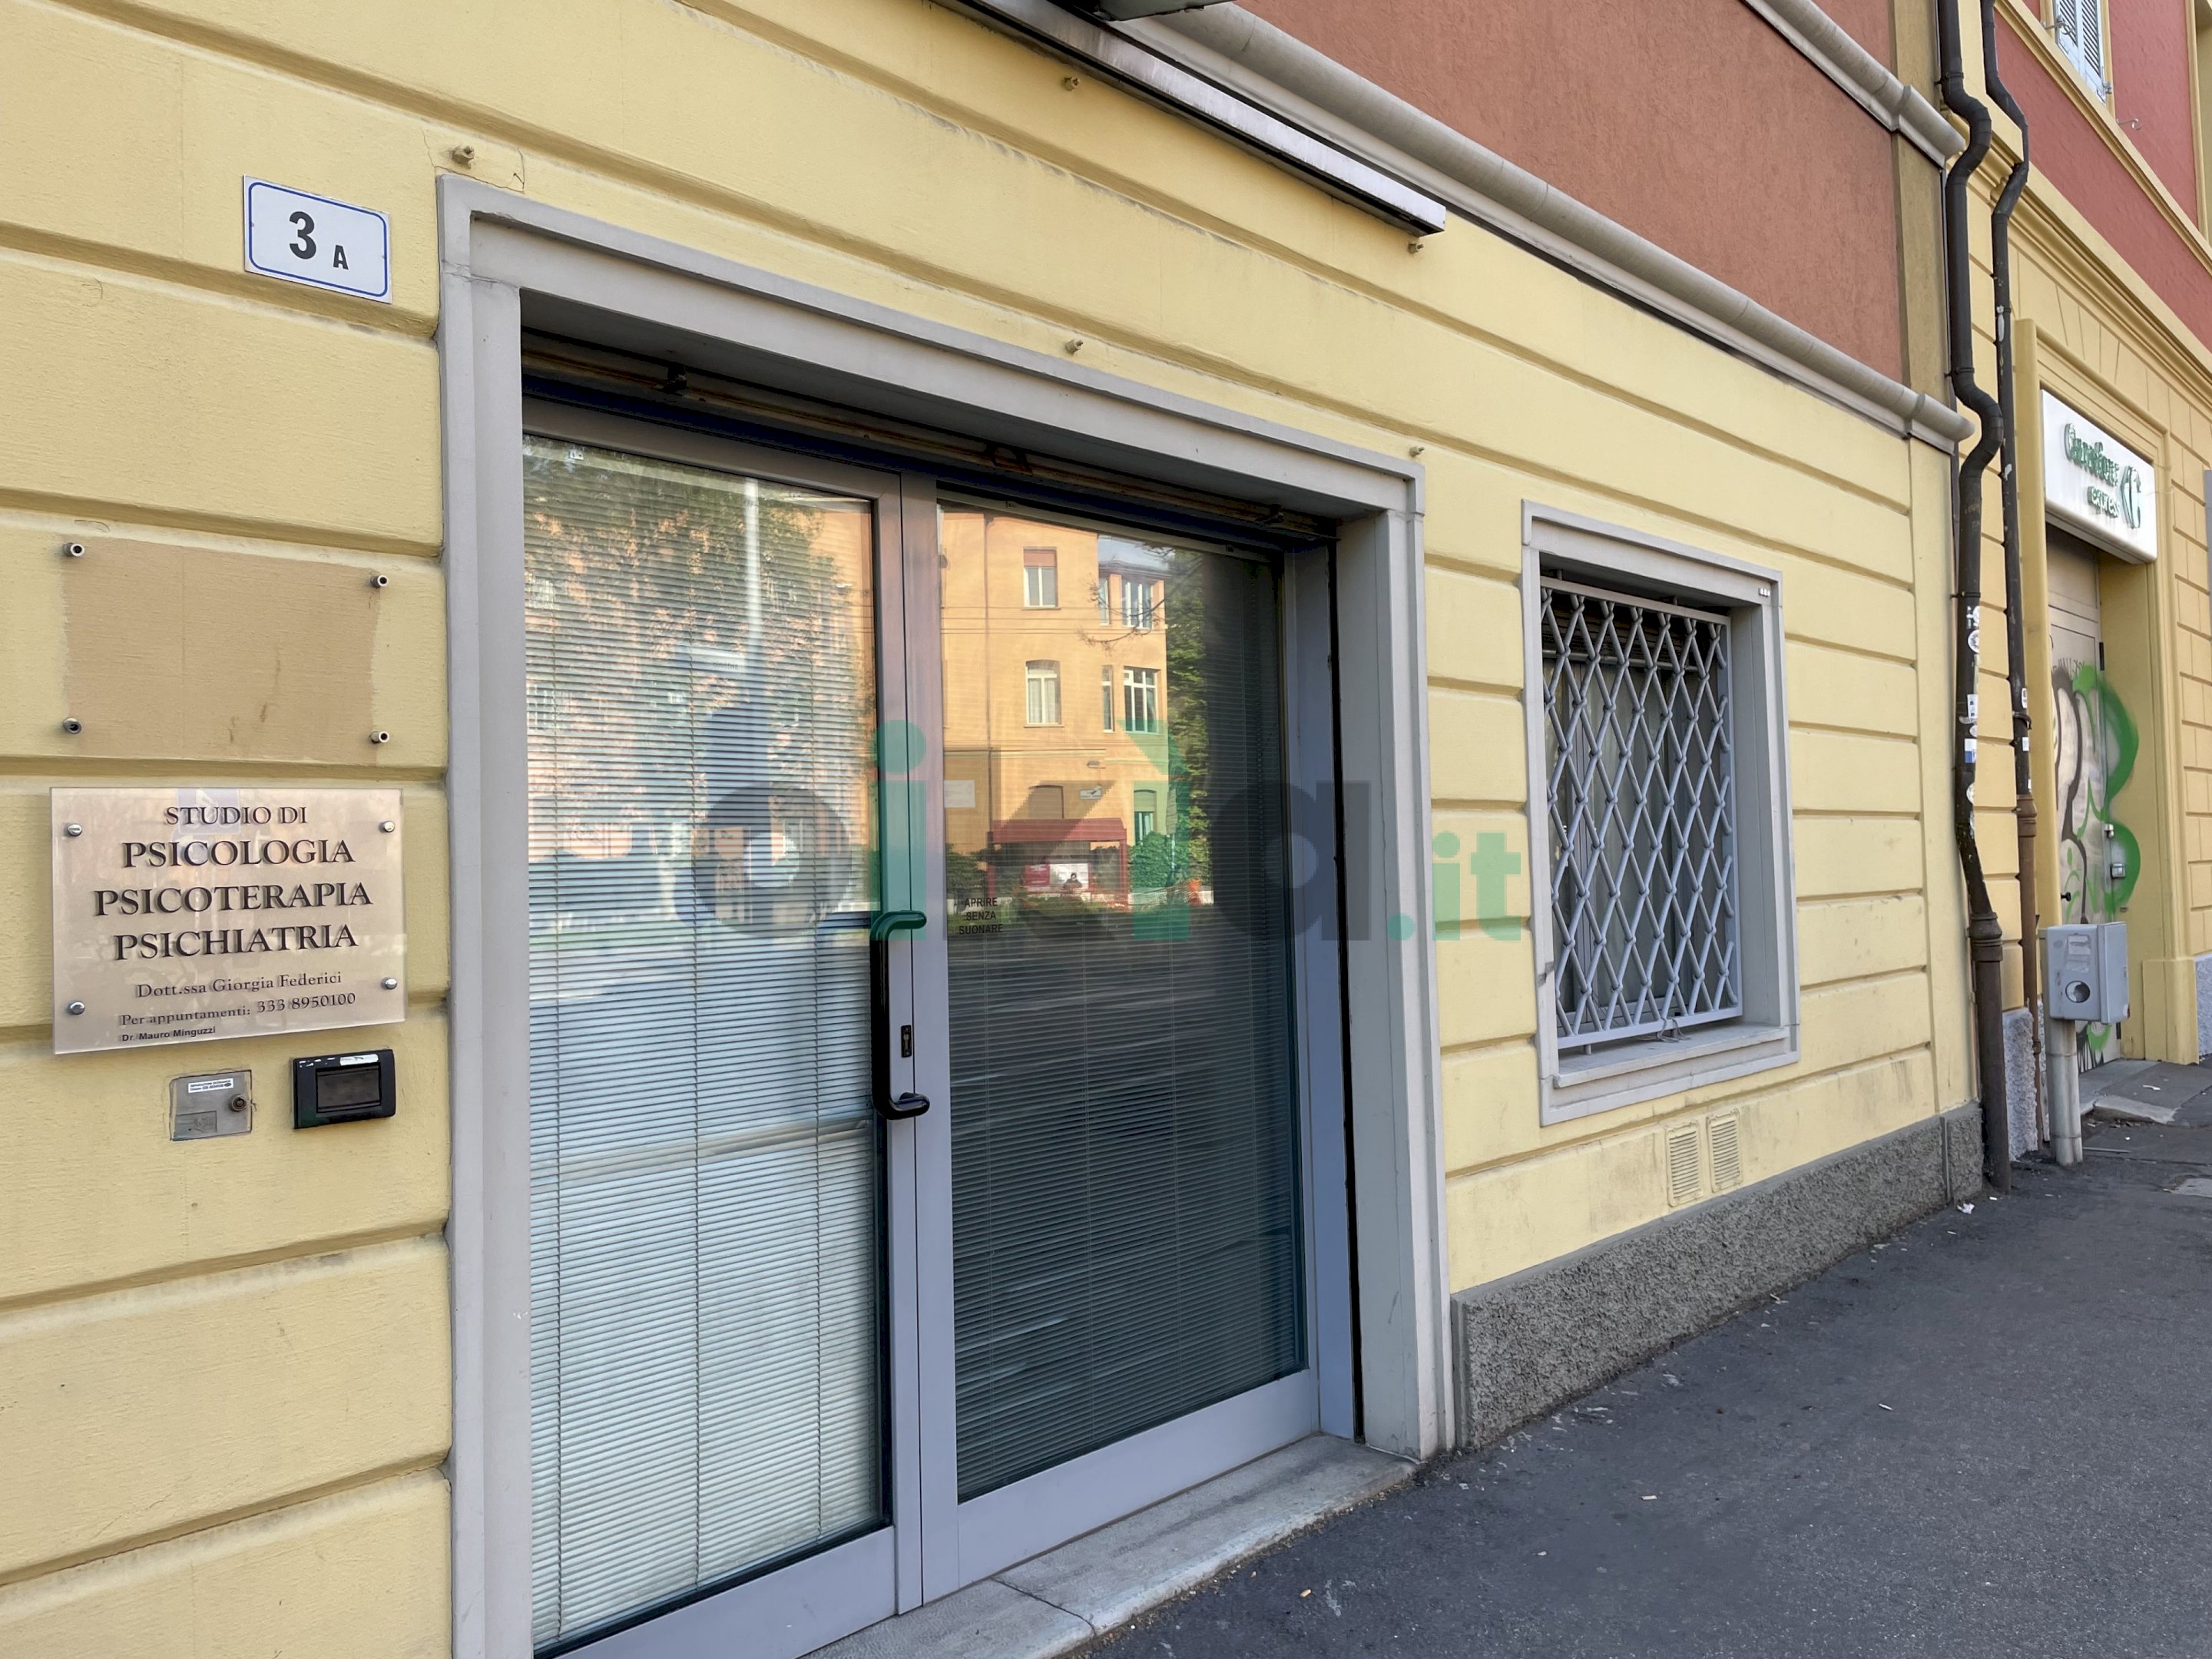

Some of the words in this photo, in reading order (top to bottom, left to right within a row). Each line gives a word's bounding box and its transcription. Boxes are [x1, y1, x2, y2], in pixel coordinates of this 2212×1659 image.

[289, 210, 316, 260] 3
[333, 244, 349, 270] A
[165, 806, 271, 826] STUDIO
[280, 806, 307, 824] DI
[122, 839, 356, 869] PSICOLOGIA
[93, 882, 373, 917] PSICOTERAPIA
[964, 897, 998, 907] APRIRE
[966, 911, 996, 921] SENZA
[113, 923, 359, 962] PSICHIATRIA
[959, 924, 1003, 935] SUONARE
[137, 983, 207, 998] Dott.ssa
[212, 977, 273, 992] Giorgia
[279, 972, 342, 987] Federici
[121, 1014, 144, 1026] Per
[149, 1005, 251, 1025] appuntamenti:
[257, 998, 286, 1014] 333
[291, 992, 356, 1011] 8950100
[139, 1031, 170, 1041] Mauro
[173, 1025, 216, 1038] Minguzzi
